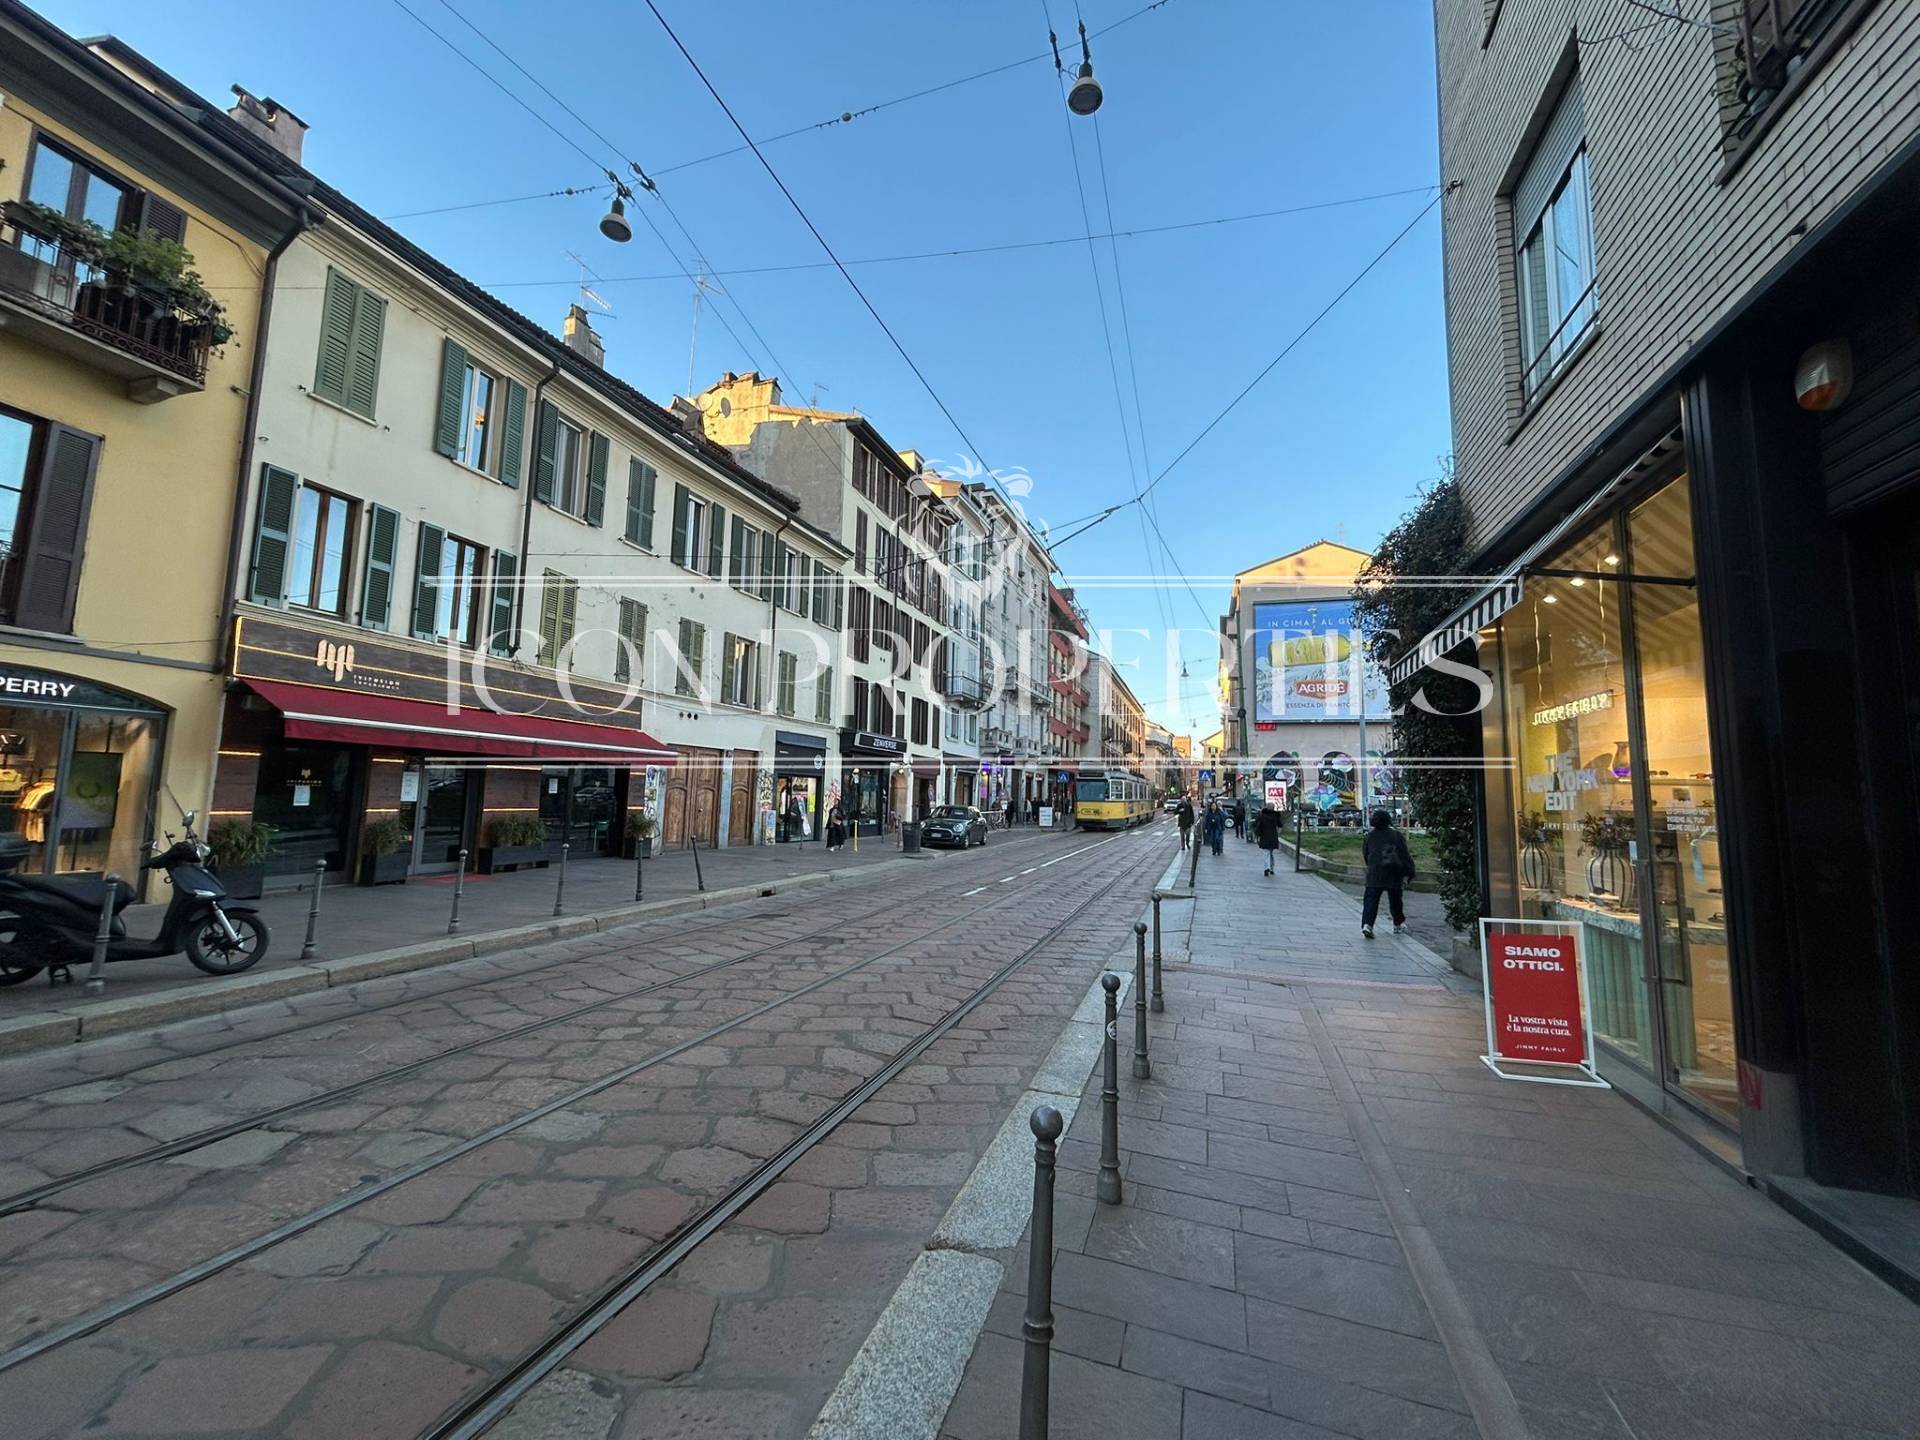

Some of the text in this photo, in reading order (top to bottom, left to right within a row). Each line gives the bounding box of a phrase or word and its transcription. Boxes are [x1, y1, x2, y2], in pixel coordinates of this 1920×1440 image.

[1267, 620, 1279, 628] IN
[1282, 619, 1310, 628] CIMA
[1321, 618, 1334, 626] AL
[1544, 753, 1573, 772] THE
[1557, 769, 1599, 792] YORK
[1545, 791, 1577, 811] EDIT
[1505, 946, 1560, 957] SIAMO
[1504, 960, 1564, 971] OTTICI.
[1508, 1014, 1568, 1027] La vostra vista
[1506, 1022, 1572, 1036] è la nostra cura.
